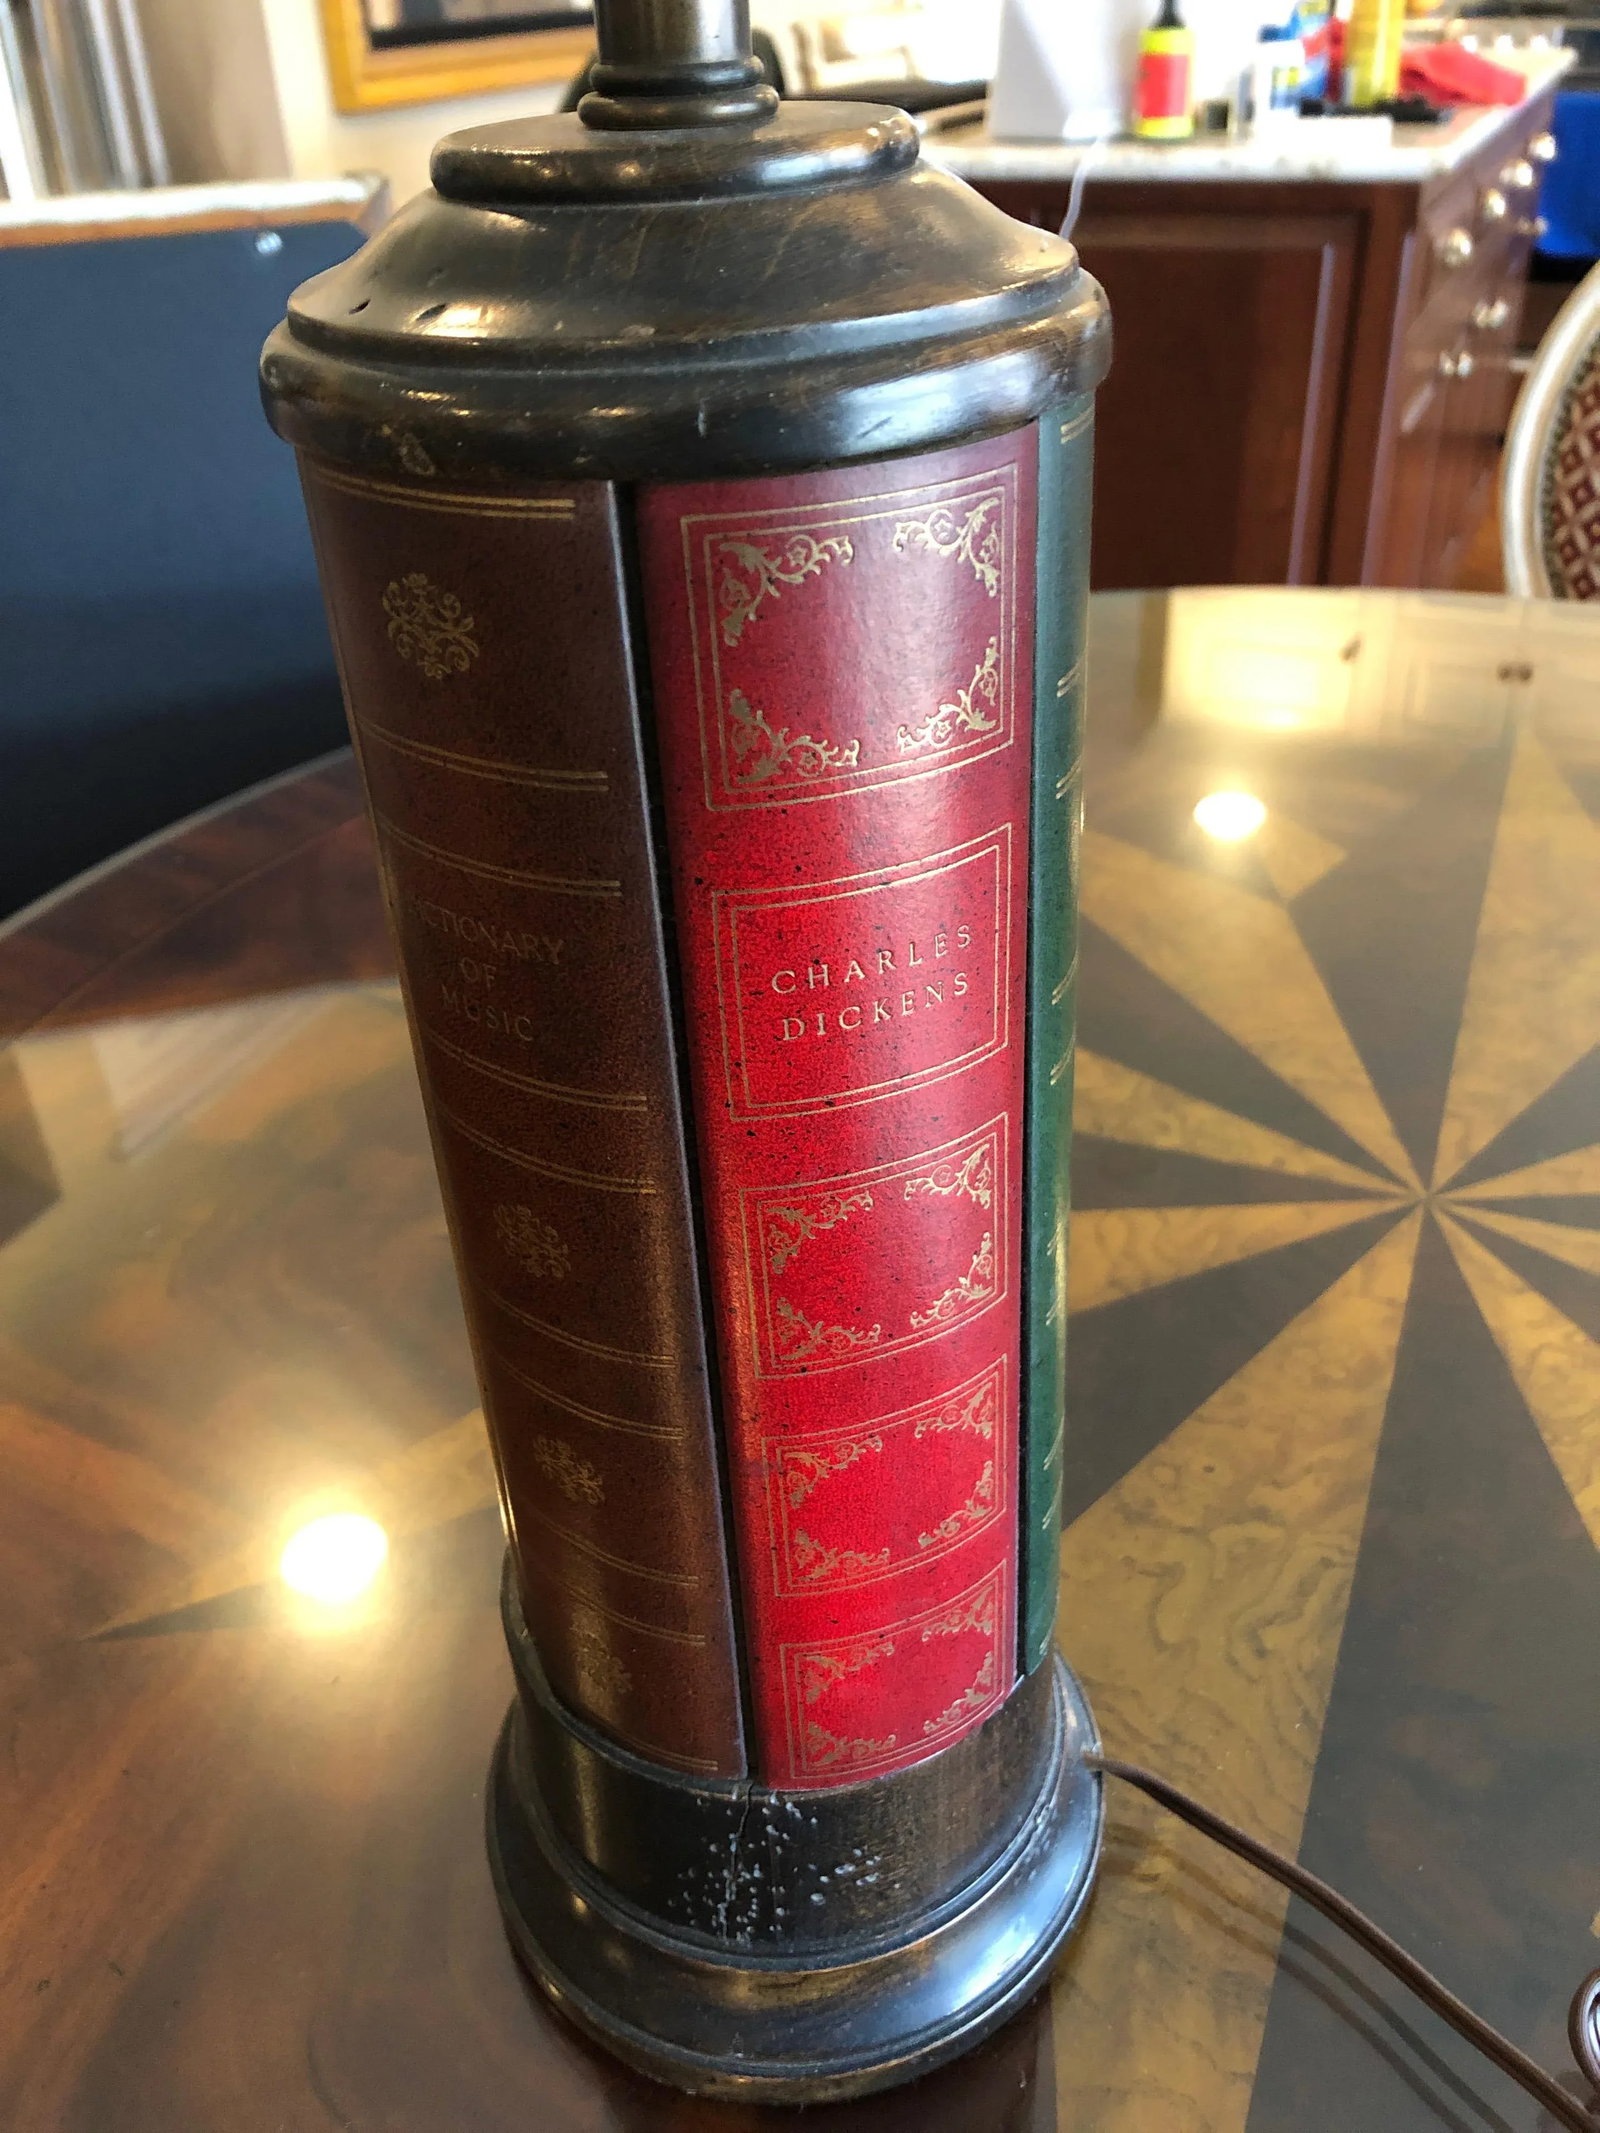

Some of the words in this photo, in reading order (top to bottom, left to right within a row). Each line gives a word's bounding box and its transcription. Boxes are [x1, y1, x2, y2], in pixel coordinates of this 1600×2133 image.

[460, 957, 497, 990] OF
[771, 925, 971, 993] CHARLES
[782, 972, 968, 1041] DICKENS
